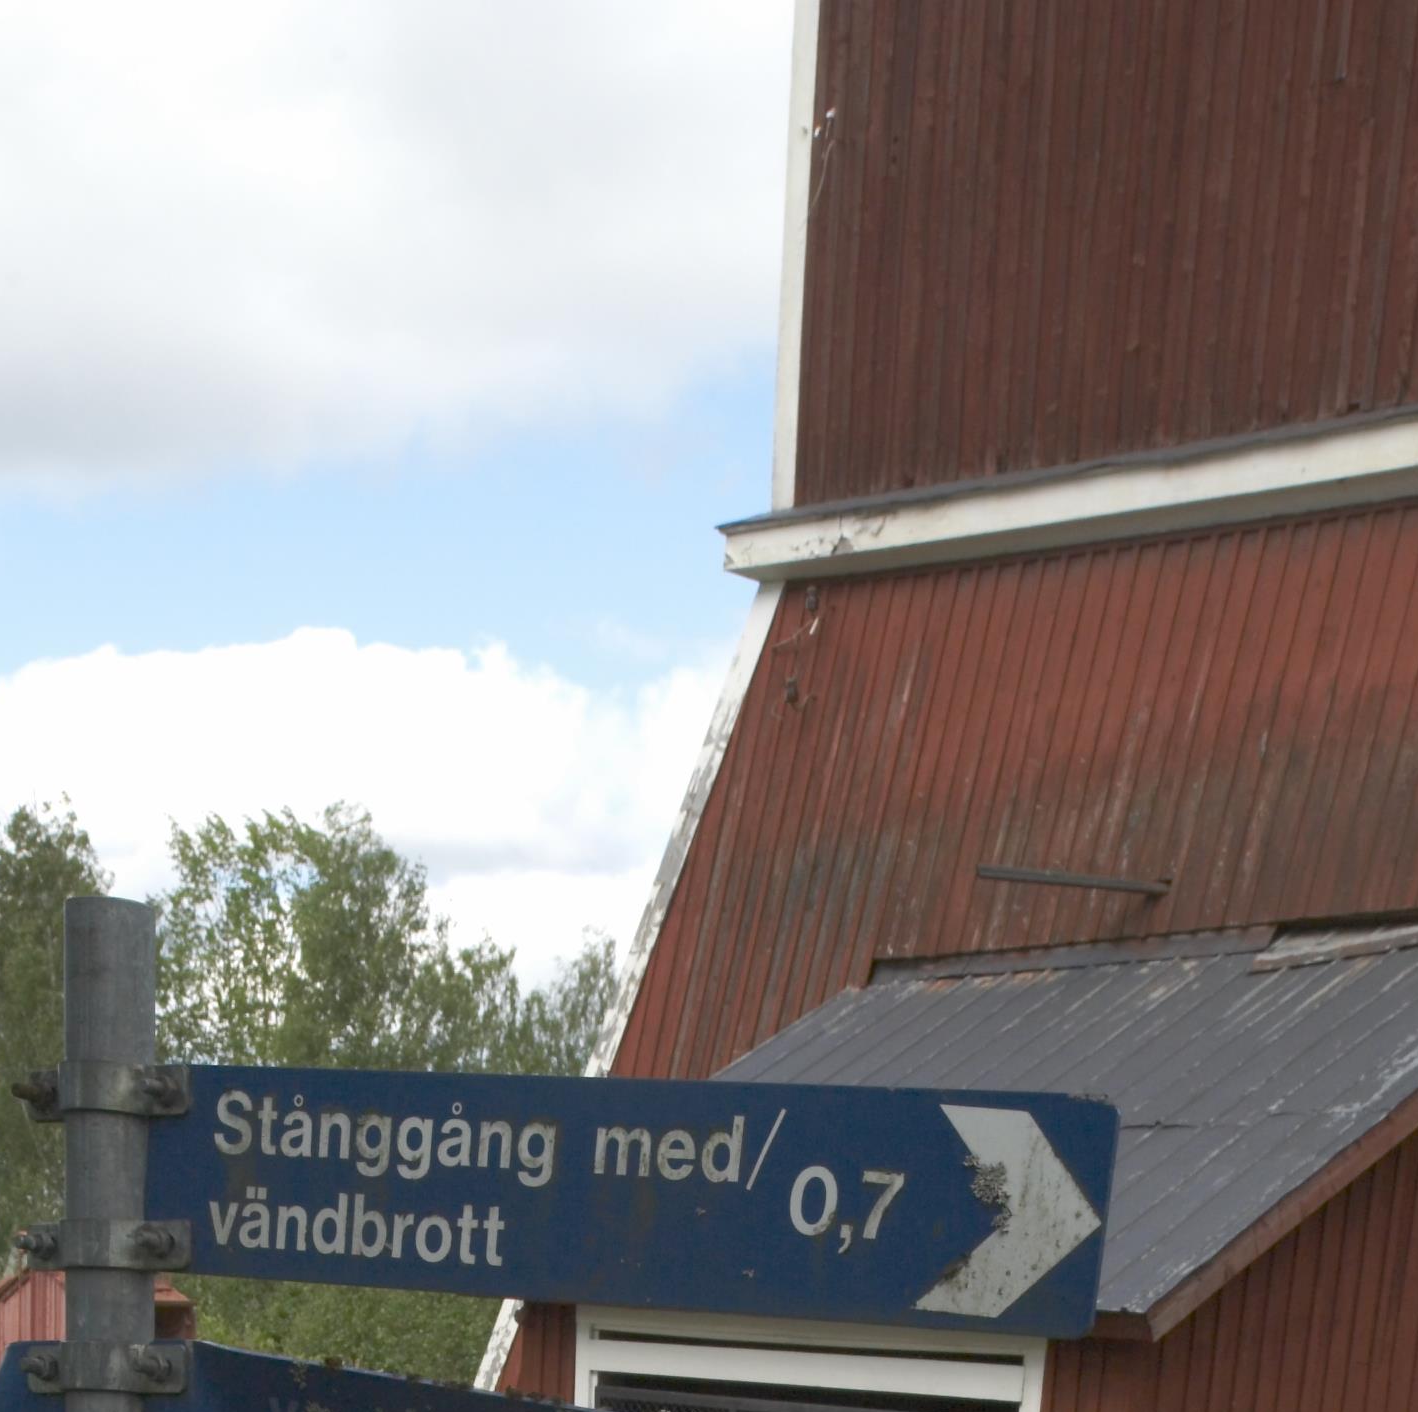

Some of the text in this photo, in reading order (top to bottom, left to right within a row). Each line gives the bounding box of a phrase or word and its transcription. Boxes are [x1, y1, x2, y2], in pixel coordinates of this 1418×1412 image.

[208, 1185, 505, 1267] vändbrott
[214, 1090, 906, 1254] Stånggång med/ 0,7
